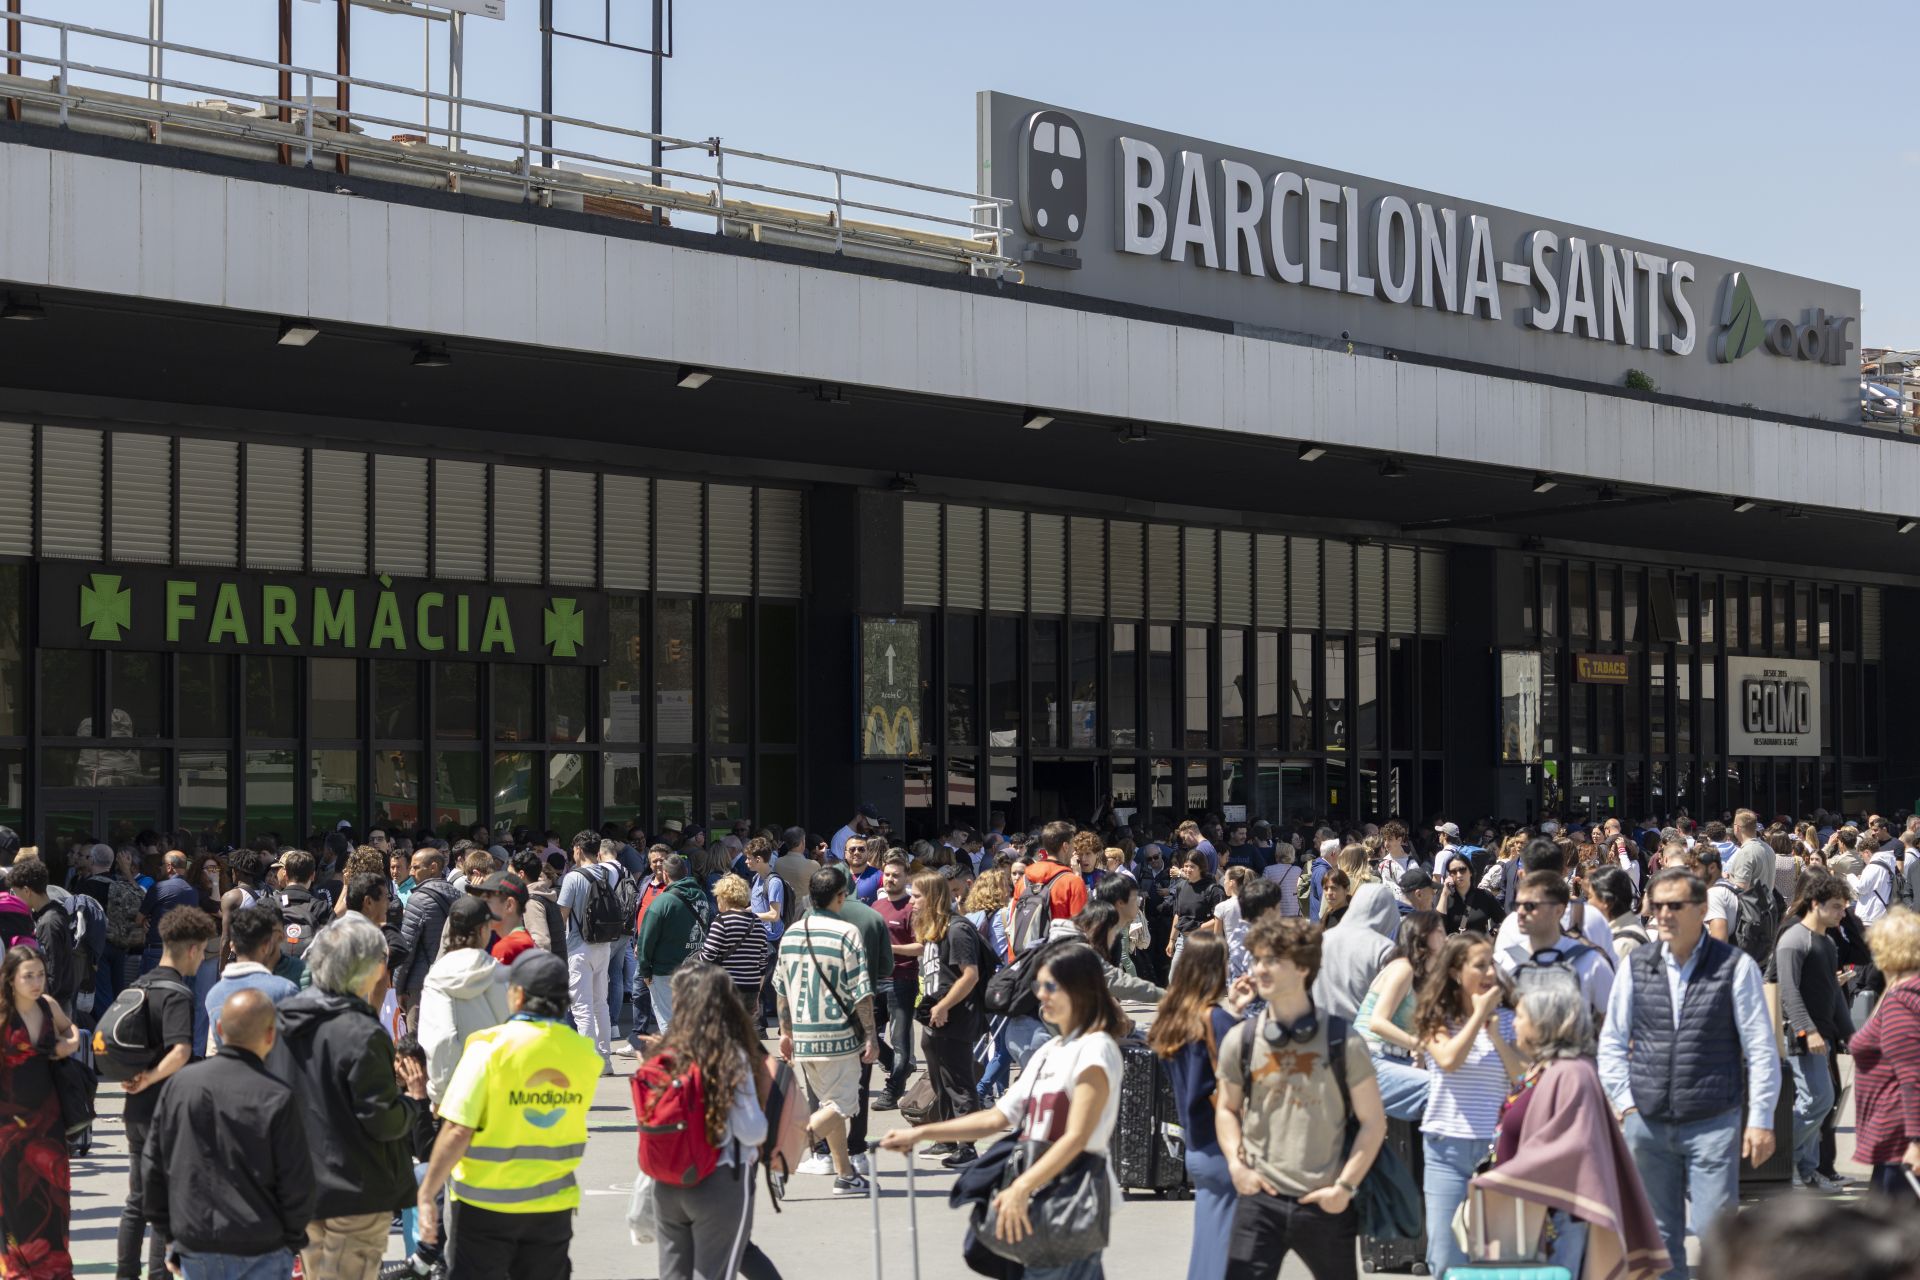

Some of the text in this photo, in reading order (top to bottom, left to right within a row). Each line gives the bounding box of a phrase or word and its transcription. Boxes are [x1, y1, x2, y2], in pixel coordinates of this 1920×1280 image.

[1114, 135, 1697, 356] BARCELONA-SANTS
[165, 572, 516, 654] FARMÀCIA
[1592, 660, 1626, 675] TABACS
[1743, 679, 1811, 734] COMO
[508, 1089, 583, 1109] Mundiplan
